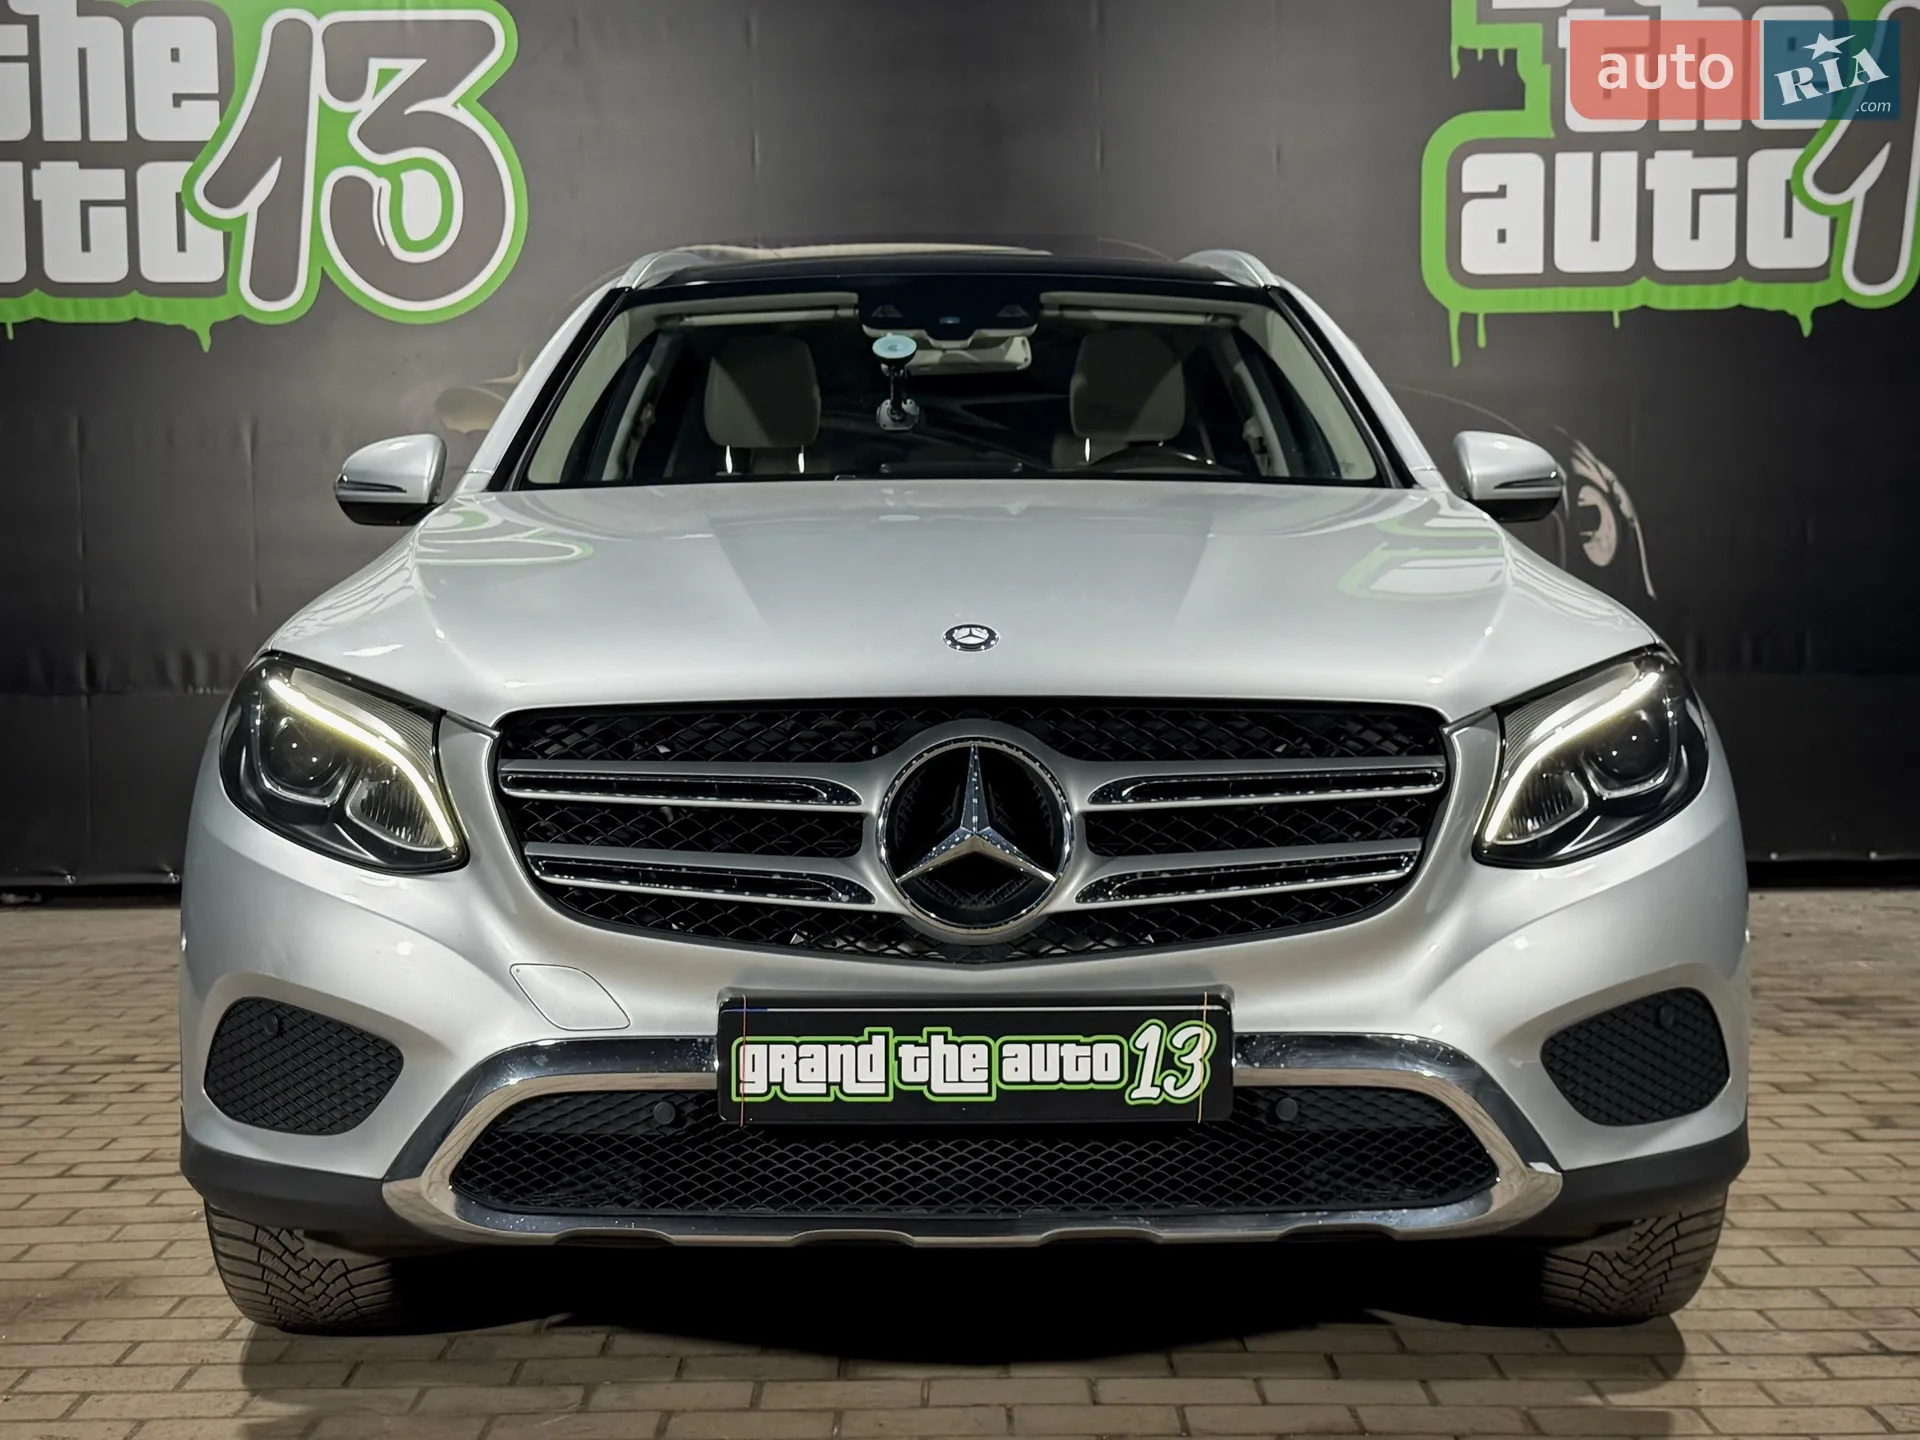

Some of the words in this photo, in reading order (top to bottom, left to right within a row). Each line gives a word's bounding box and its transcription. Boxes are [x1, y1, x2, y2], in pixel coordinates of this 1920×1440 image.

[194, 9, 515, 312] 13
[1461, 148, 1830, 275] auto
[898, 1034, 989, 1094] the
[1002, 1042, 1121, 1083] auto
[1130, 1024, 1211, 1099] 13
